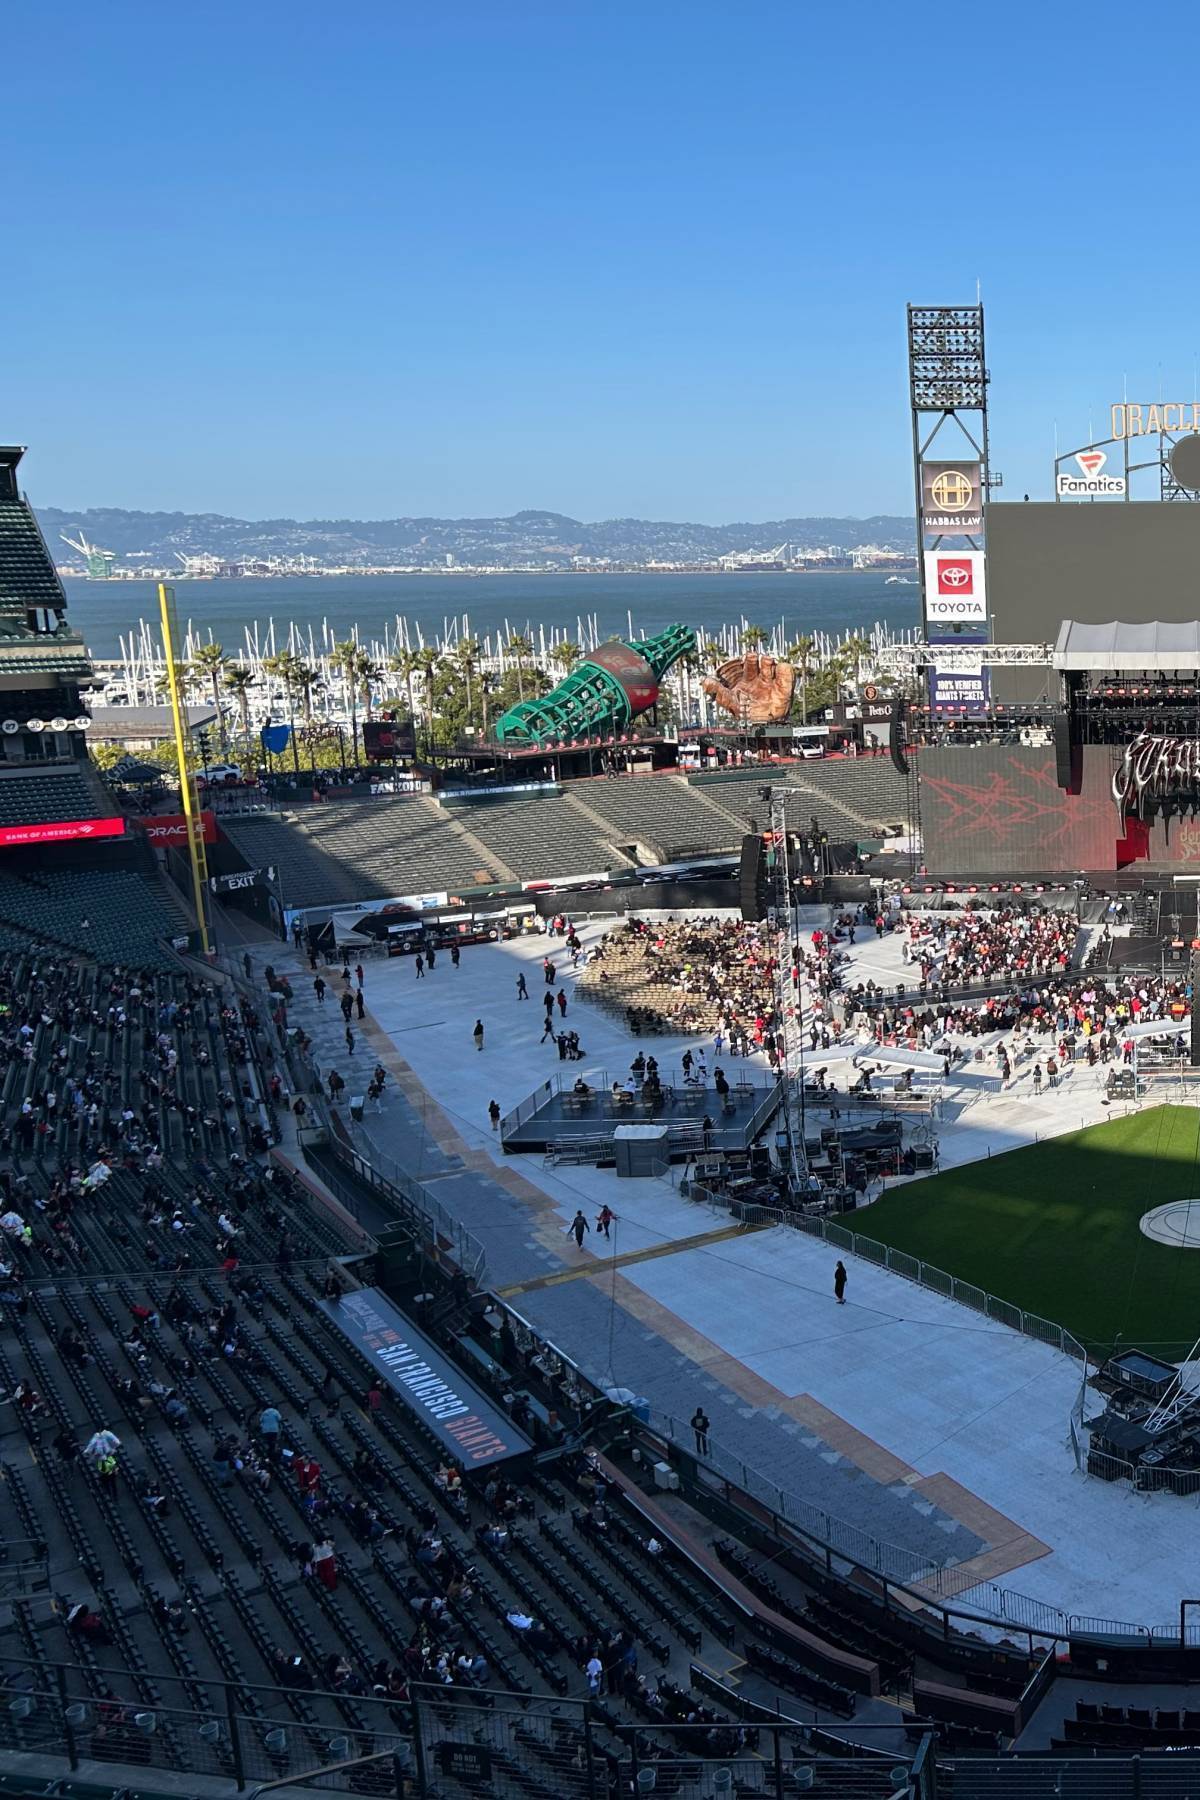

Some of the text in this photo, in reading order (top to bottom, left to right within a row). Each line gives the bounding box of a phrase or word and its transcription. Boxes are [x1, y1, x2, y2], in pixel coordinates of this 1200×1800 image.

[1060, 477, 1123, 491] Fanatics
[925, 517, 980, 525] HABBAS LAW
[930, 603, 982, 613] TOYOTA
[935, 691, 958, 700] GIANTS
[5, 832, 28, 840] BANK
[228, 876, 255, 890] EXIT
[376, 1343, 508, 1460] SAN FRANCISCO GIANTS
